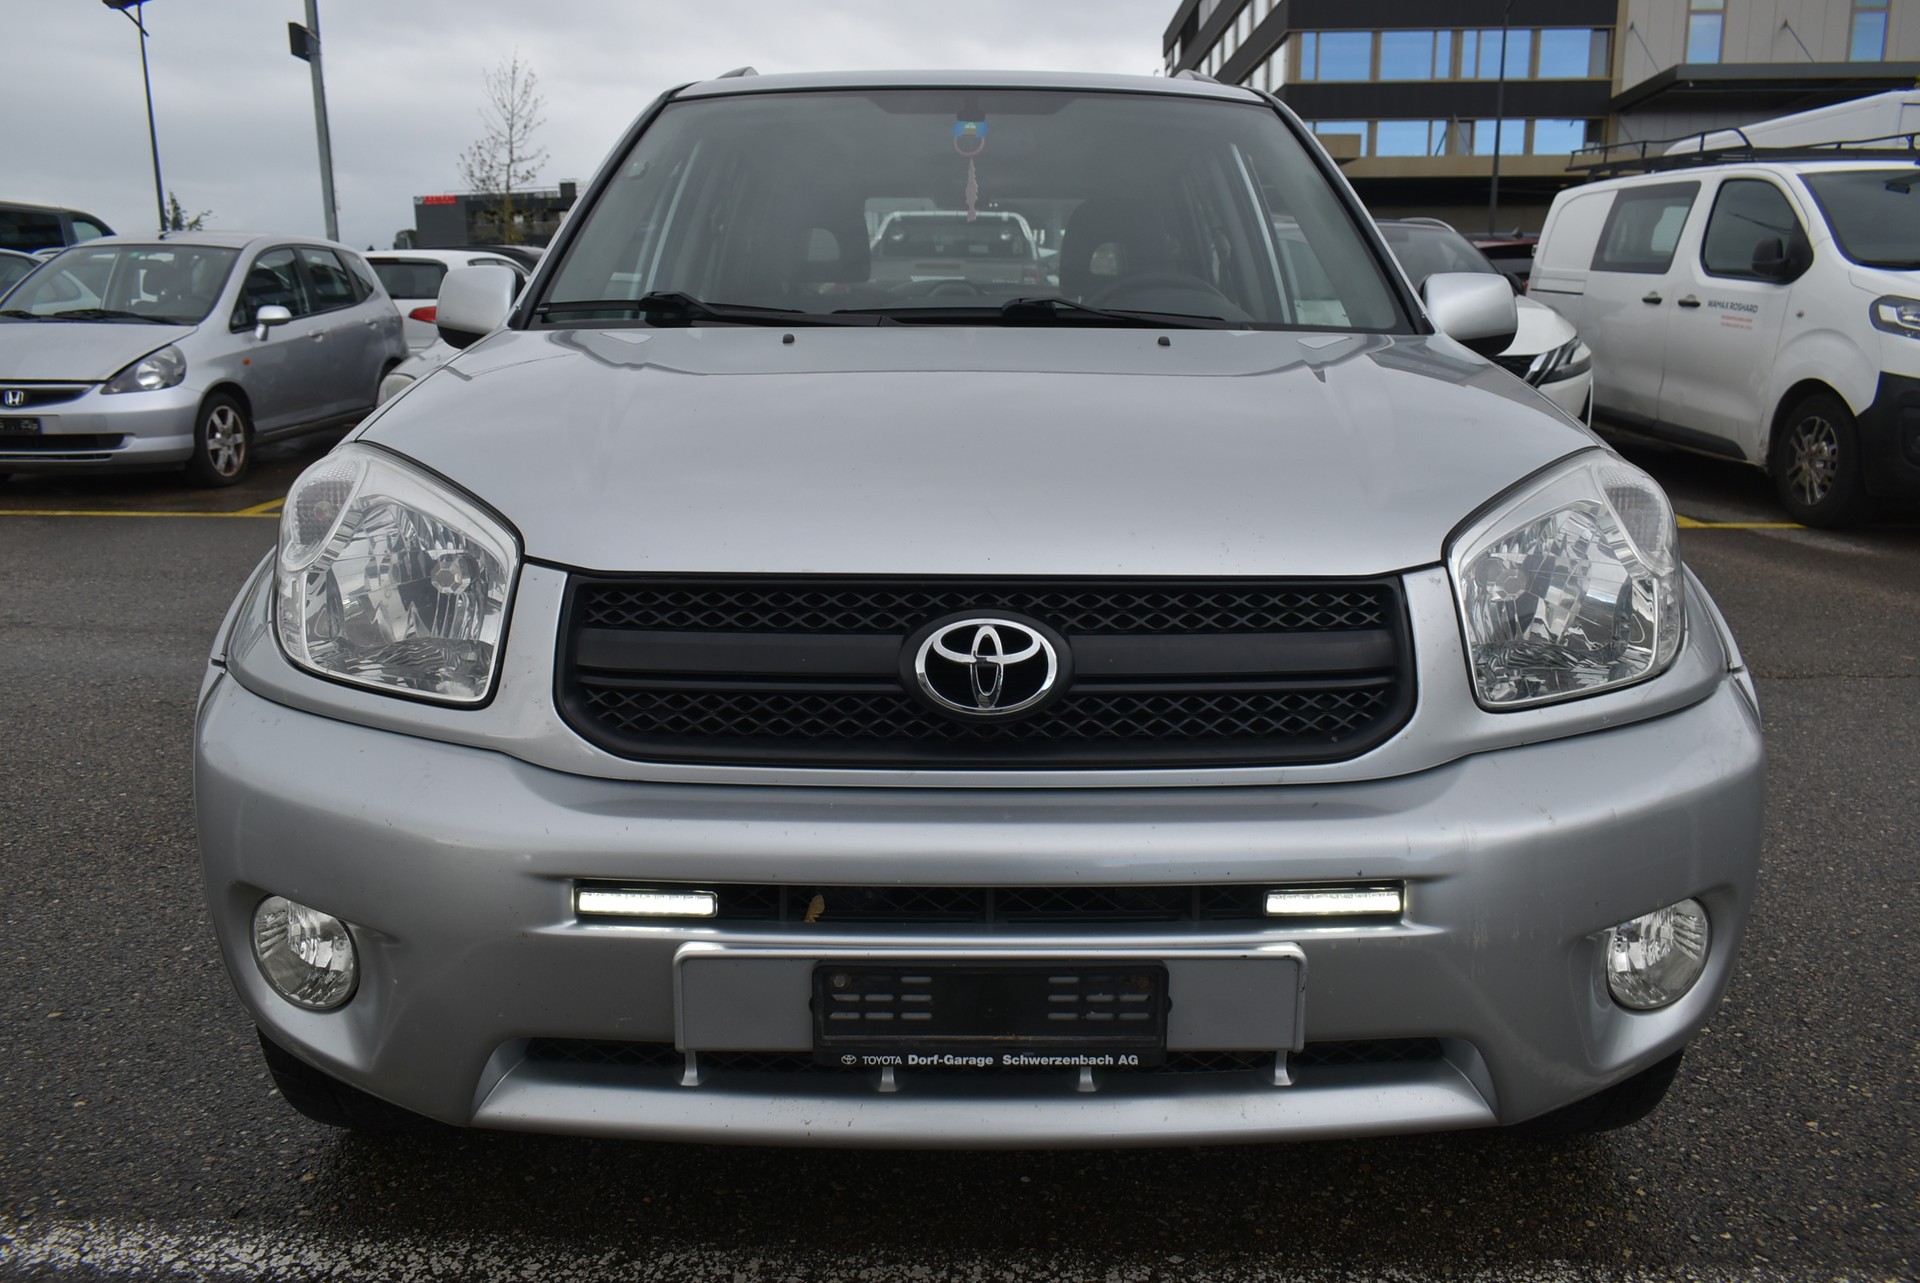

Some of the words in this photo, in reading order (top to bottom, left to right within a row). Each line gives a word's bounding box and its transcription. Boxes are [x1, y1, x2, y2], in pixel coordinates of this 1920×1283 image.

[862, 1055, 902, 1065] TOYOTA
[907, 1054, 994, 1068] Dorf-Garage
[1002, 1054, 1114, 1066] Schwerzenbach
[1117, 1054, 1139, 1066] AG
